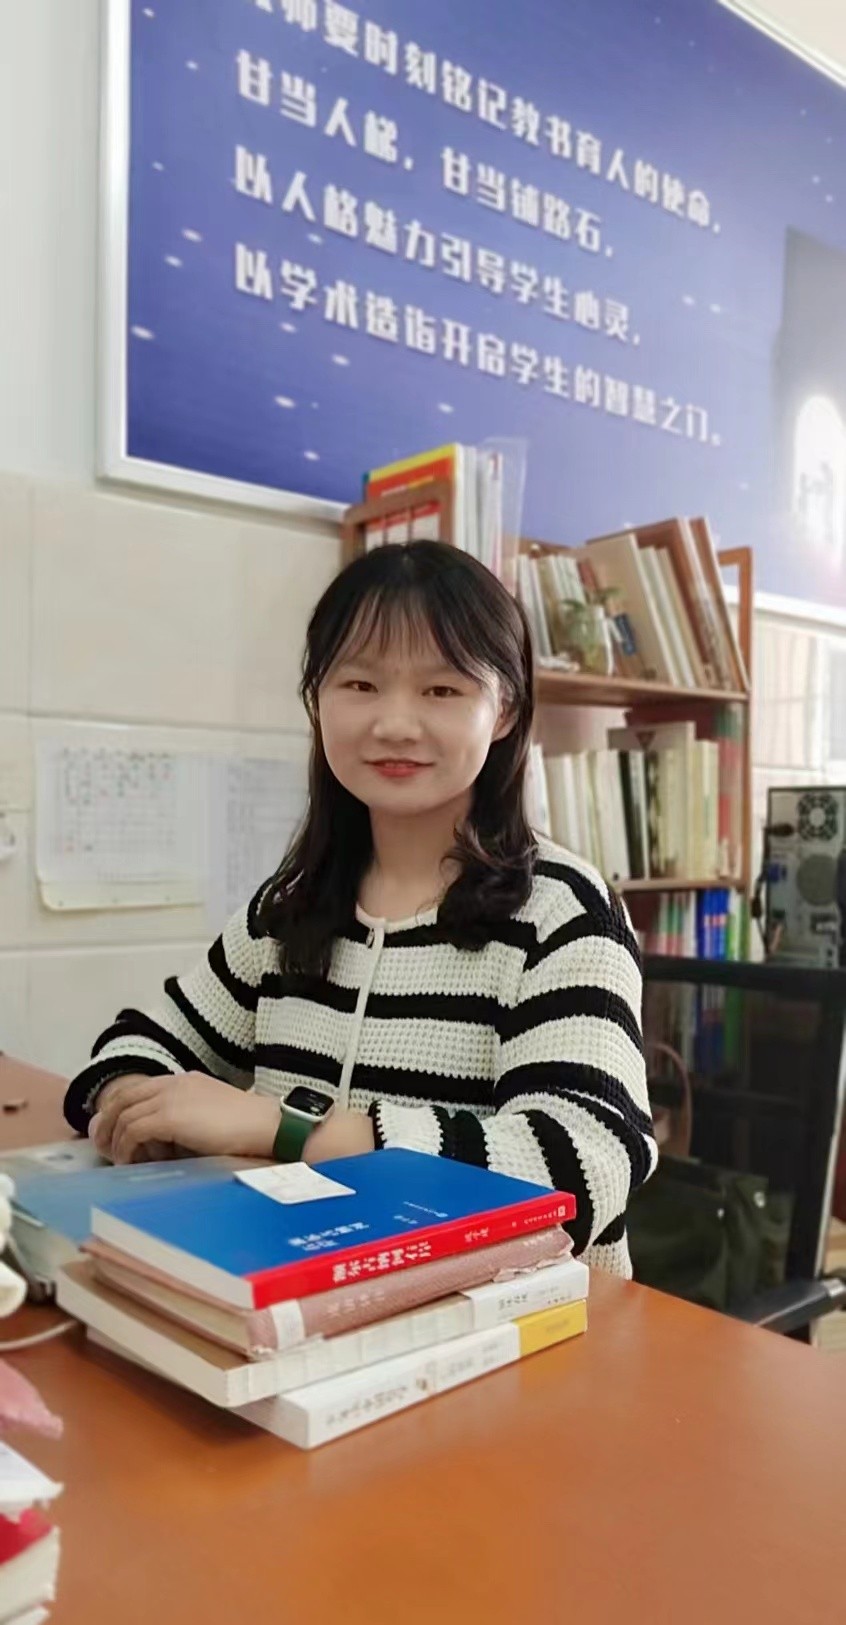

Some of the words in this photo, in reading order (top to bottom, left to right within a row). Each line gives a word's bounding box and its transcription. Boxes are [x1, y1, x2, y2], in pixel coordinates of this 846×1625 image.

[254, 0, 721, 233] 师要时刻铭记教书育人的使命，
[233, 144, 640, 345] 以人格魅力引导学生心灵，
[235, 242, 722, 446] 以学术造诣开启学生的智慧之门。
